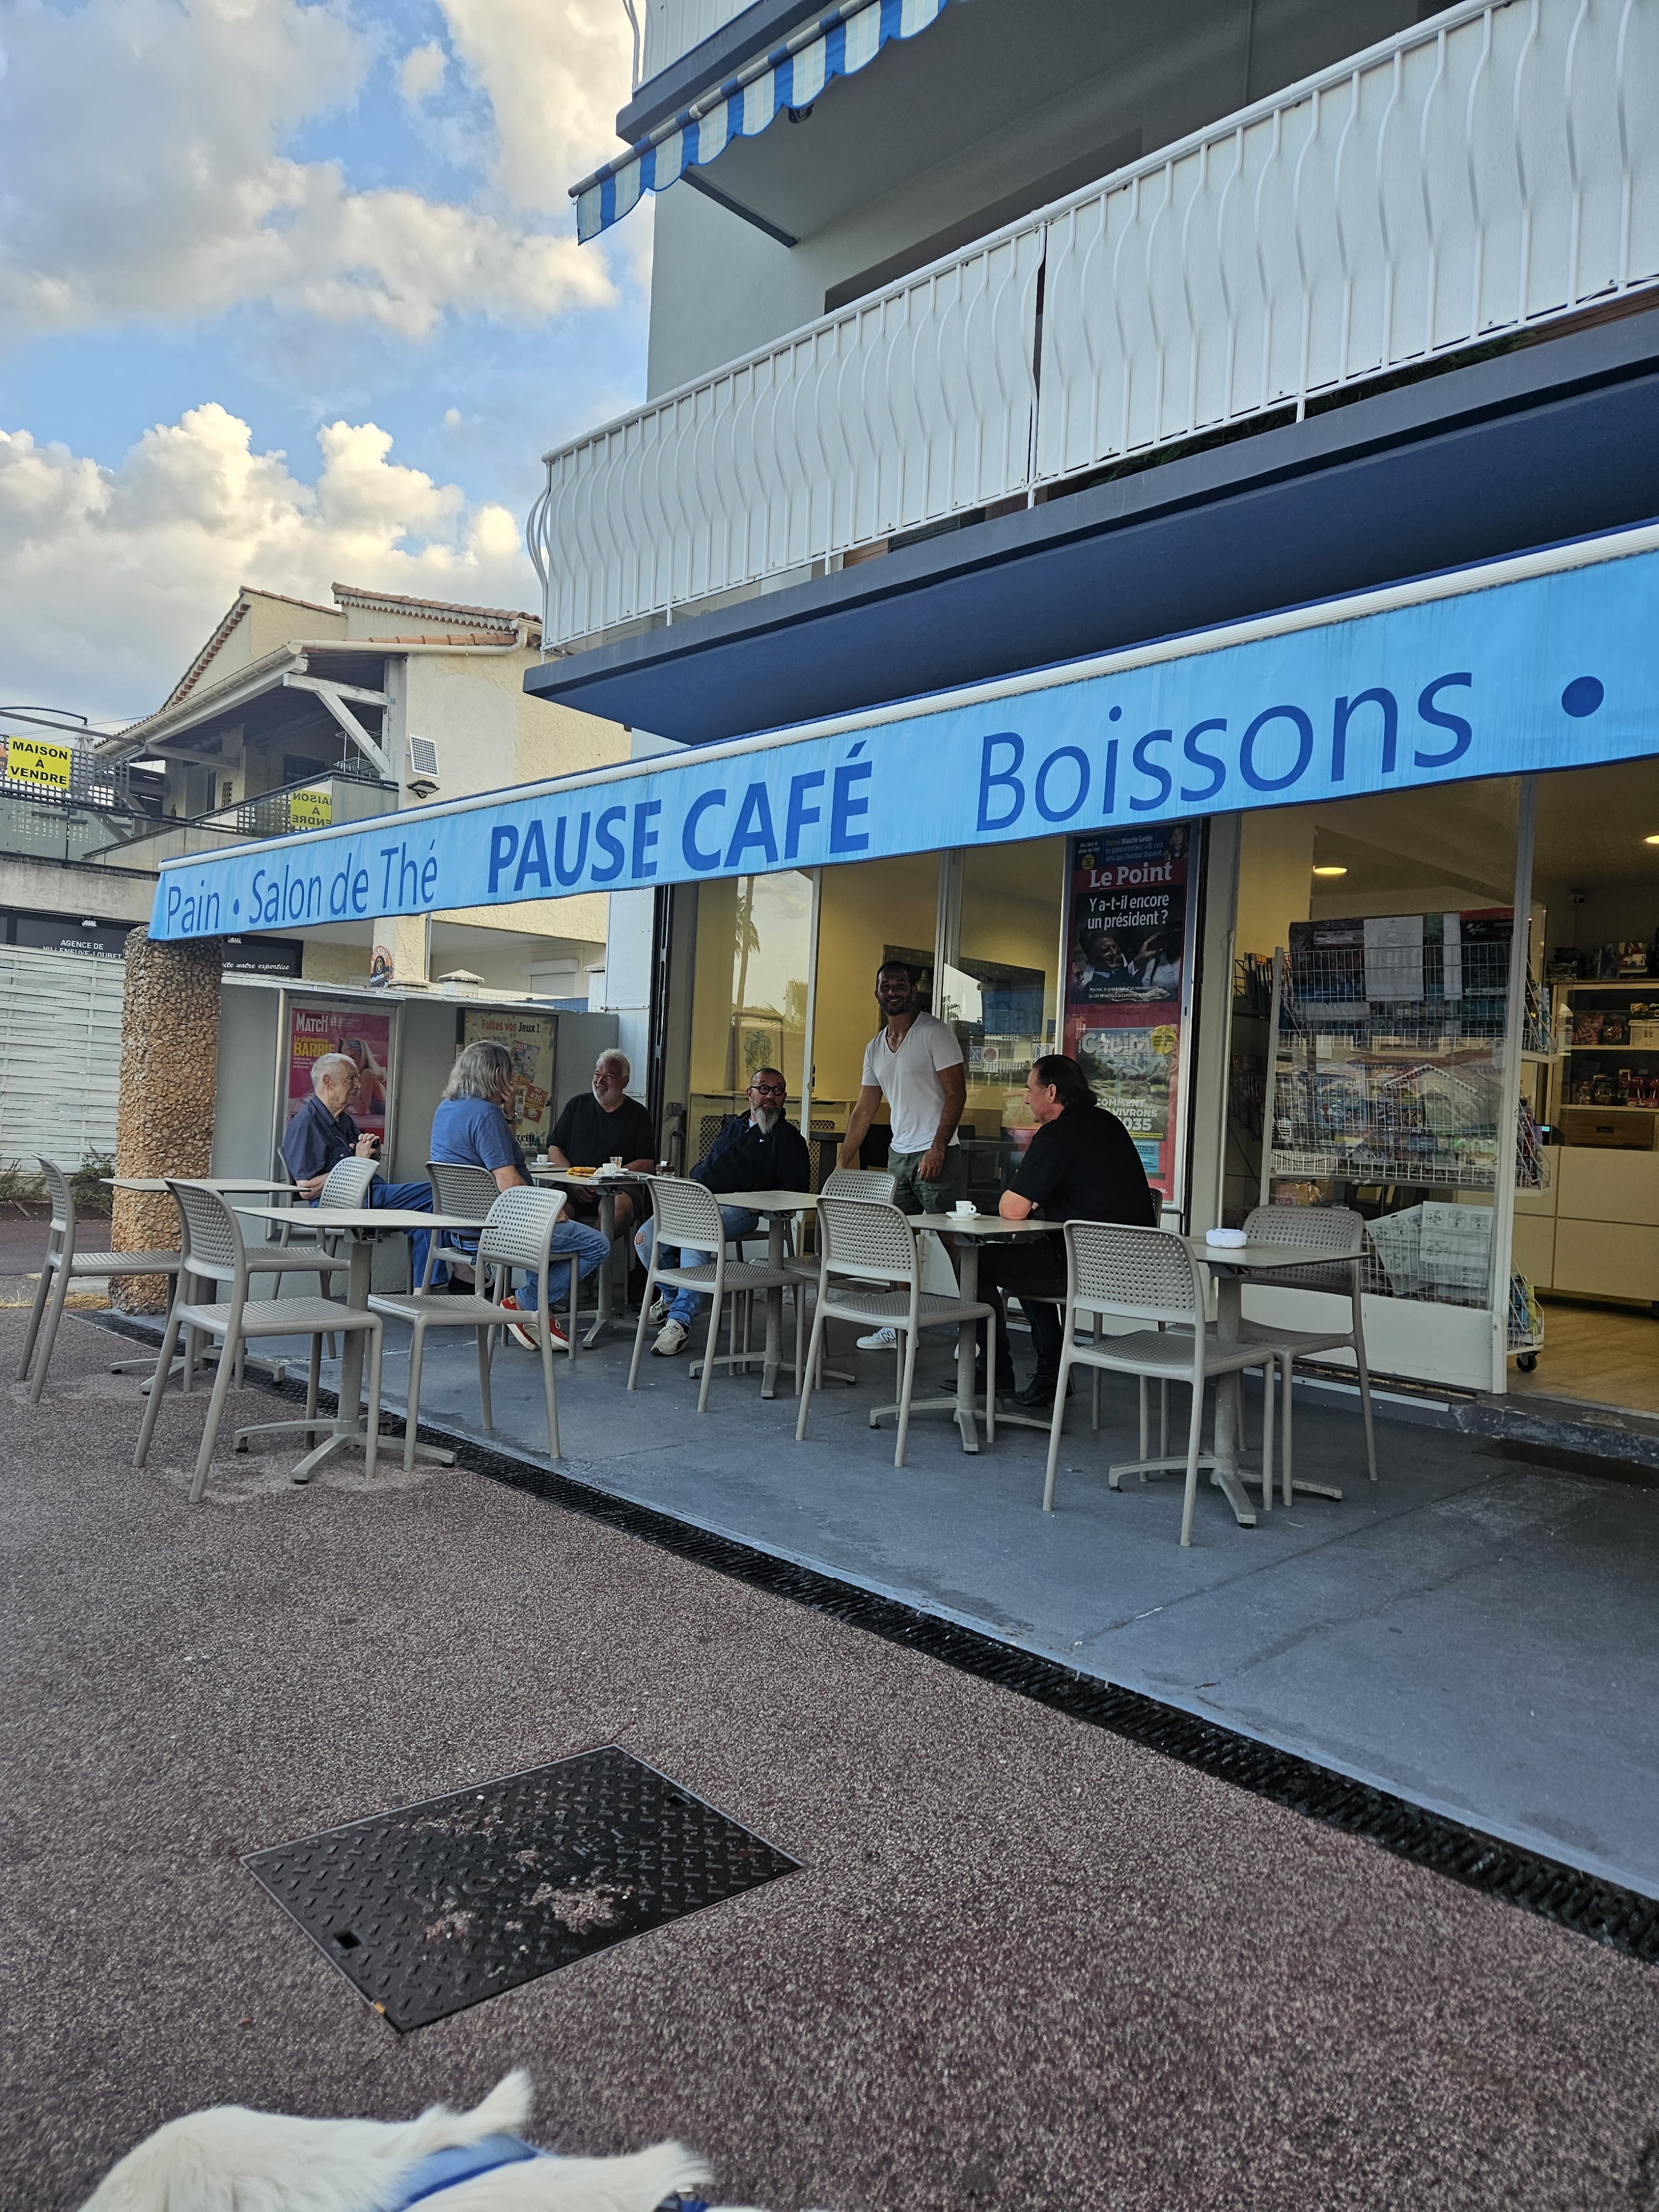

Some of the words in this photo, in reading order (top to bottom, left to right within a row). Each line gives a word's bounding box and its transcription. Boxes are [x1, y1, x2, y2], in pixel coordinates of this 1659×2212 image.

[13, 741, 67, 760] MAISON
[35, 757, 44, 768] À
[10, 765, 67, 785] VENDRE
[167, 880, 220, 935] Pain
[249, 864, 321, 924] Salon
[330, 852, 368, 915] de
[380, 838, 438, 909] Thé
[487, 799, 662, 894] PAUSE
[682, 739, 873, 872] CAFÉ
[976, 672, 1472, 832] Boissons
[1089, 869, 1113, 888] Le
[1116, 862, 1172, 885] Point
[1089, 898, 1098, 912] Y
[1098, 895, 1128, 911] a-t-il
[1129, 894, 1170, 909] encore
[1088, 917, 1102, 930] un
[1104, 910, 1159, 931] président
[1161, 910, 1168, 925] ?
[60, 940, 92, 949] AGENCE
[482, 1019, 503, 1030] Faites
[504, 1023, 517, 1031] vos
[518, 1022, 535, 1033] Jeux
[294, 1042, 335, 1057] BARBIE
[1082, 1032, 1157, 1057] Capital
[530, 1092, 542, 1101] 420
[1097, 1098, 1146, 1108] COMMENT
[1112, 1108, 1157, 1118] VIVRONS
[1117, 1117, 1152, 1131] 035
[881, 1331, 896, 1343] N
